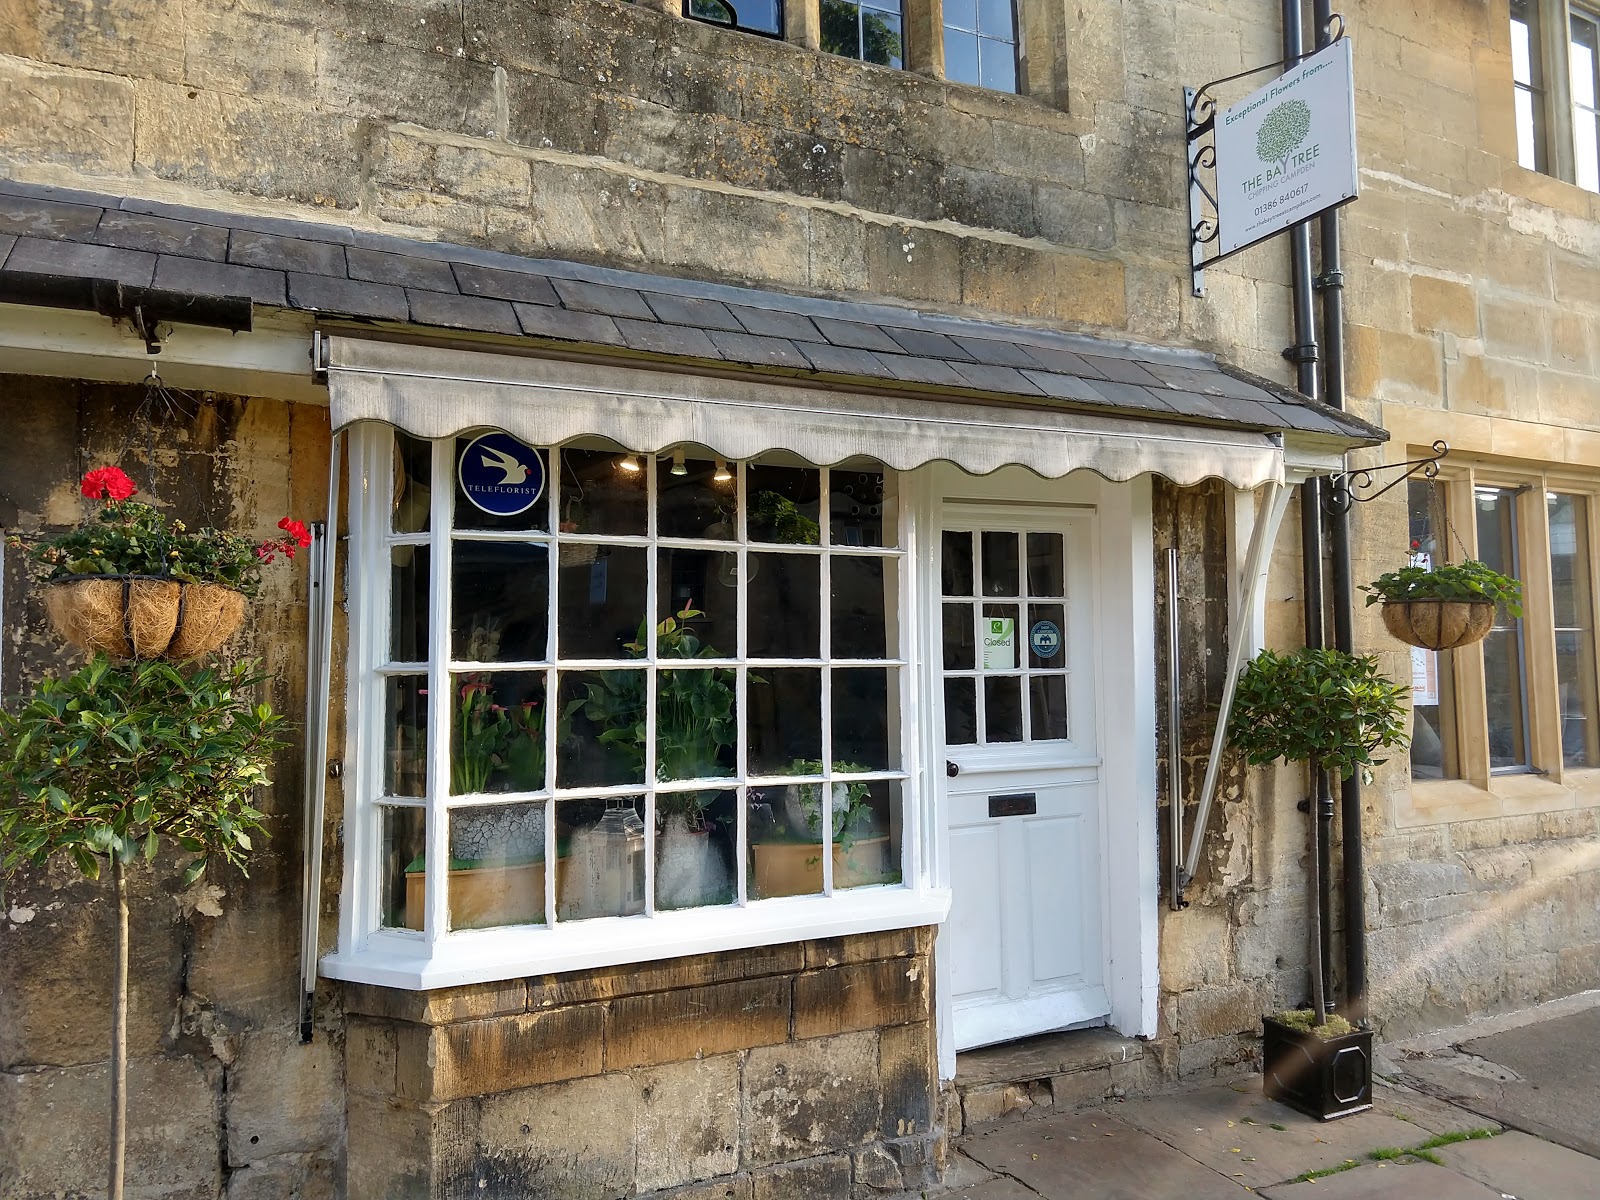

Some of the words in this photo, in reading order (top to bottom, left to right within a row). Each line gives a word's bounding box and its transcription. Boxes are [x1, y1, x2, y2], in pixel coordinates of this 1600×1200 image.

[1225, 93, 1268, 126] Exceptional
[1270, 76, 1300, 99] Flowers
[1242, 174, 1262, 194] THE
[1266, 152, 1291, 182] BAY
[1291, 144, 1320, 168] TREE
[1247, 180, 1279, 201] CHIPPING
[1280, 161, 1316, 184] CAMPDEN
[1254, 199, 1278, 216] 01386
[1279, 183, 1309, 205] 840617
[468, 485, 536, 494] TELEFLORIST
[984, 637, 1011, 646] Closed
